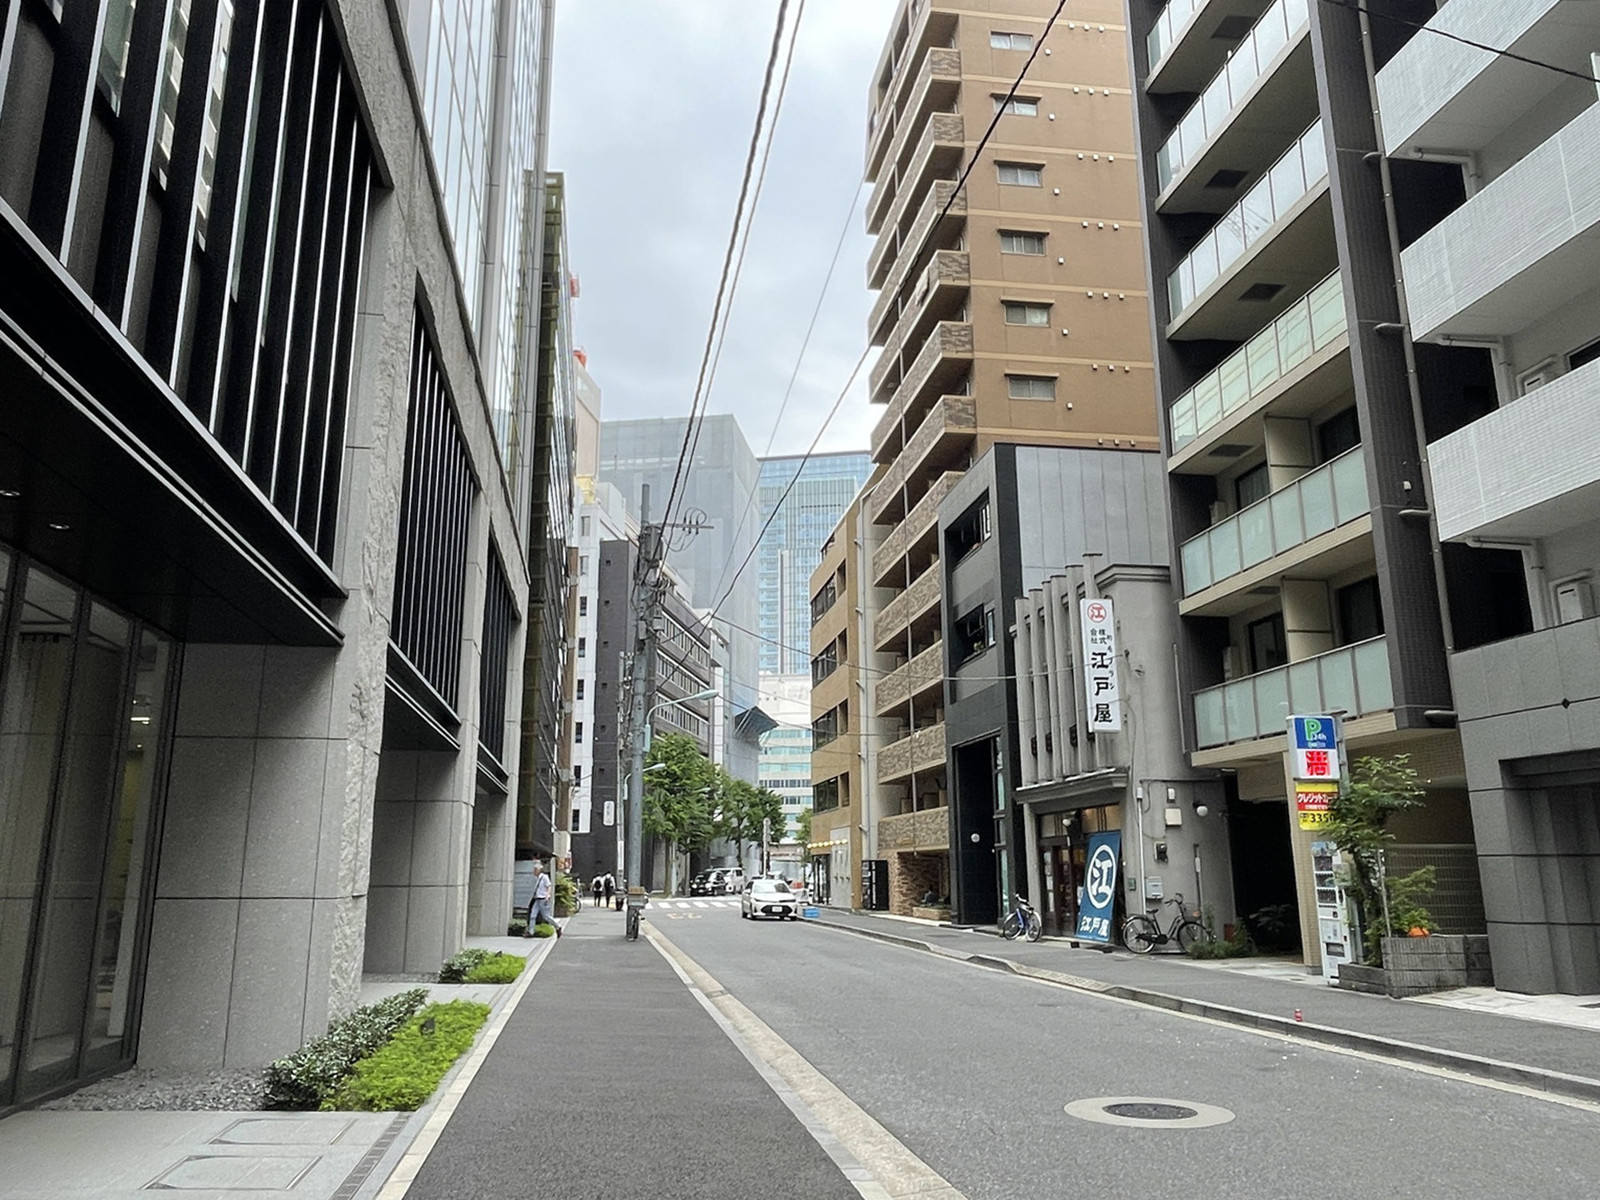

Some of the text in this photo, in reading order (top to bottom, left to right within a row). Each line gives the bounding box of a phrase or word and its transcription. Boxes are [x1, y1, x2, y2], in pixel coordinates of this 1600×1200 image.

[1089, 605, 1105, 620] 江
[1091, 651, 1113, 723] 江戸屋
[1304, 718, 1321, 742] P
[1090, 855, 1114, 898] 江
[1080, 915, 1110, 938] 江戸屋
